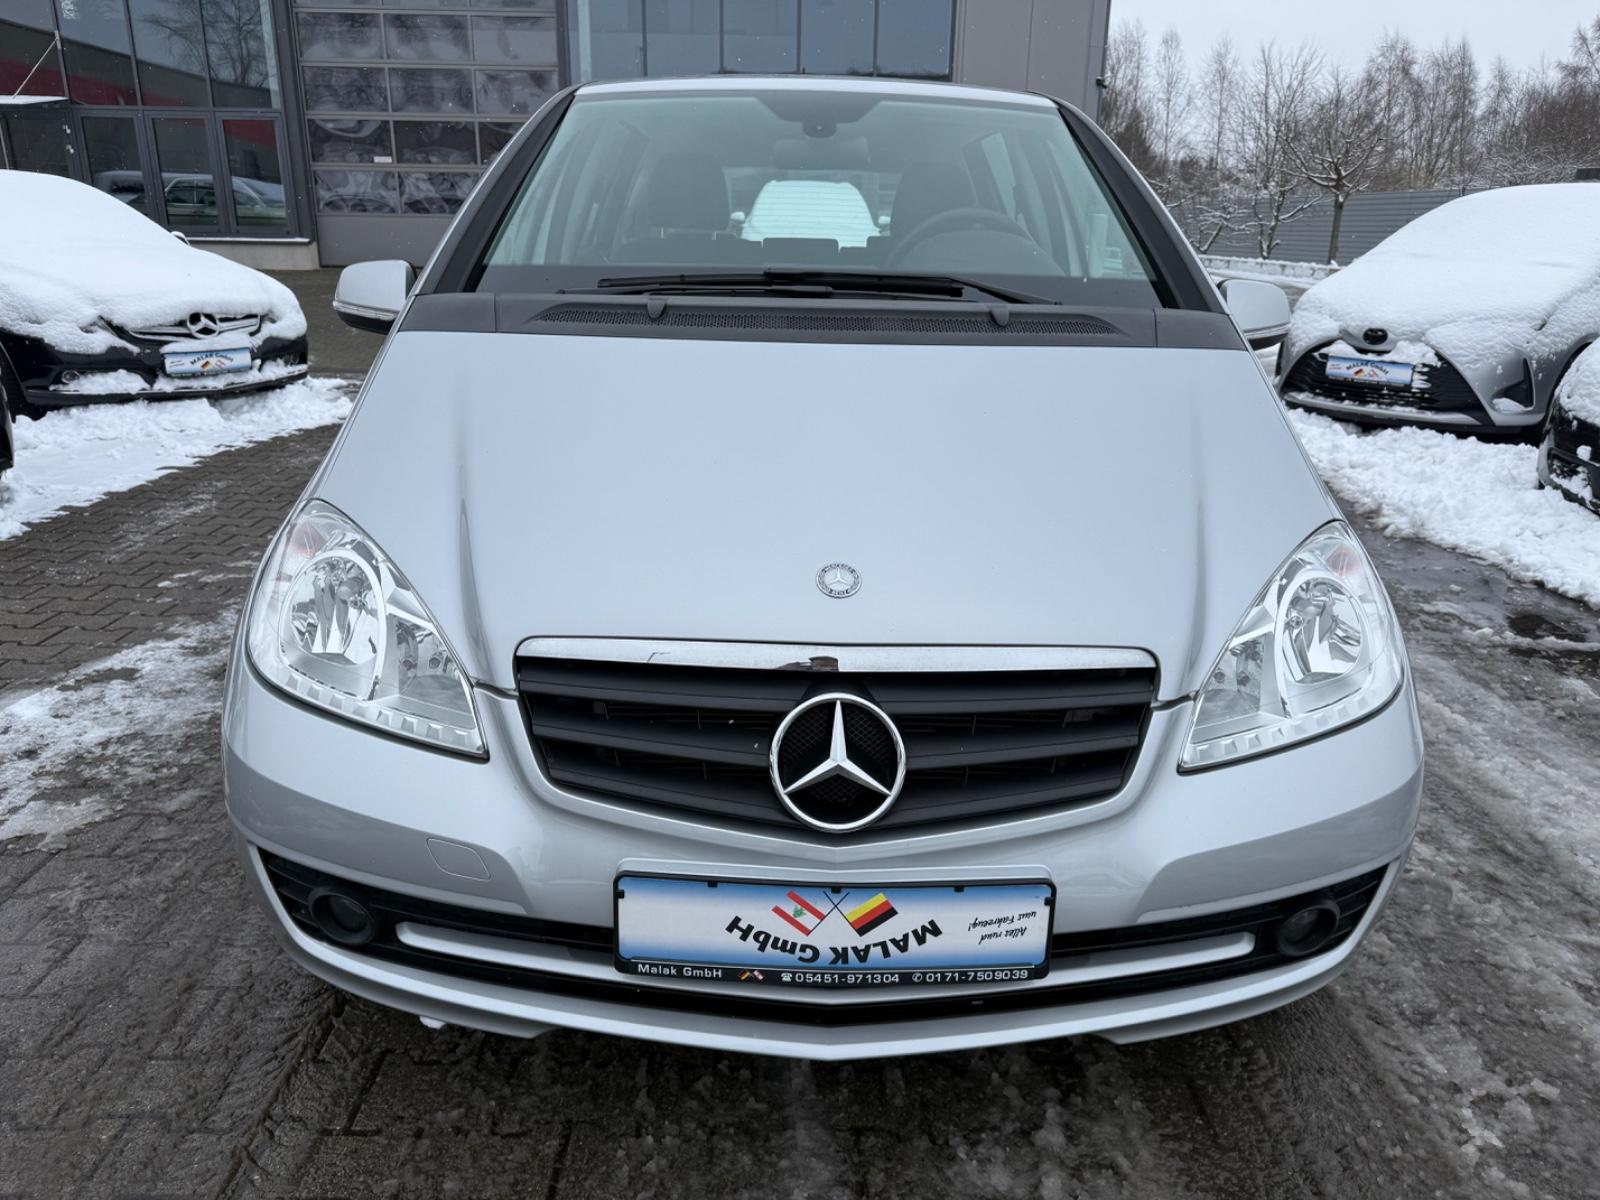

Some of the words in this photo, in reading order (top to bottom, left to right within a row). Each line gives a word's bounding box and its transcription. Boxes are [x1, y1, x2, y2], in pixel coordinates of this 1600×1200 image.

[967, 913, 1015, 932] Fahrzeug!
[725, 915, 820, 963] GmbH
[978, 930, 1003, 945] rund
[1004, 926, 1028, 938] Alles
[829, 919, 943, 965] MALAK
[637, 963, 678, 976] Malak
[682, 967, 723, 979] GmbH
